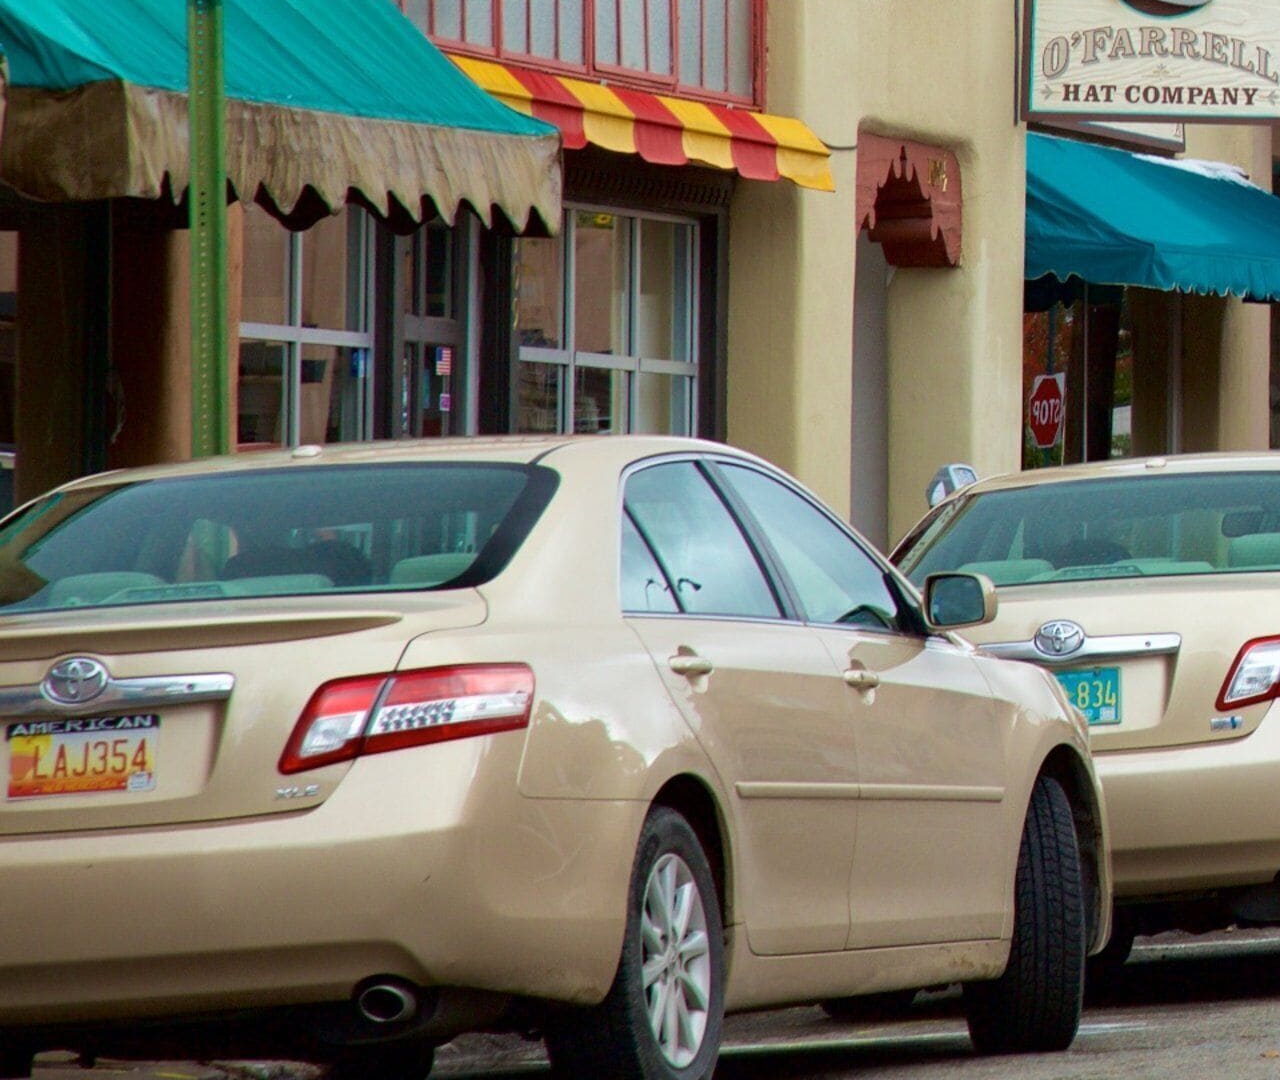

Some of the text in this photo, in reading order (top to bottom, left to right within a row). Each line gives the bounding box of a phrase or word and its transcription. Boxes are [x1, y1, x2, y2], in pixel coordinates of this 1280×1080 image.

[1062, 83, 1259, 106] HAT COMPANY
[10, 715, 154, 737] AMERICAN
[33, 737, 148, 781] LAJ354
